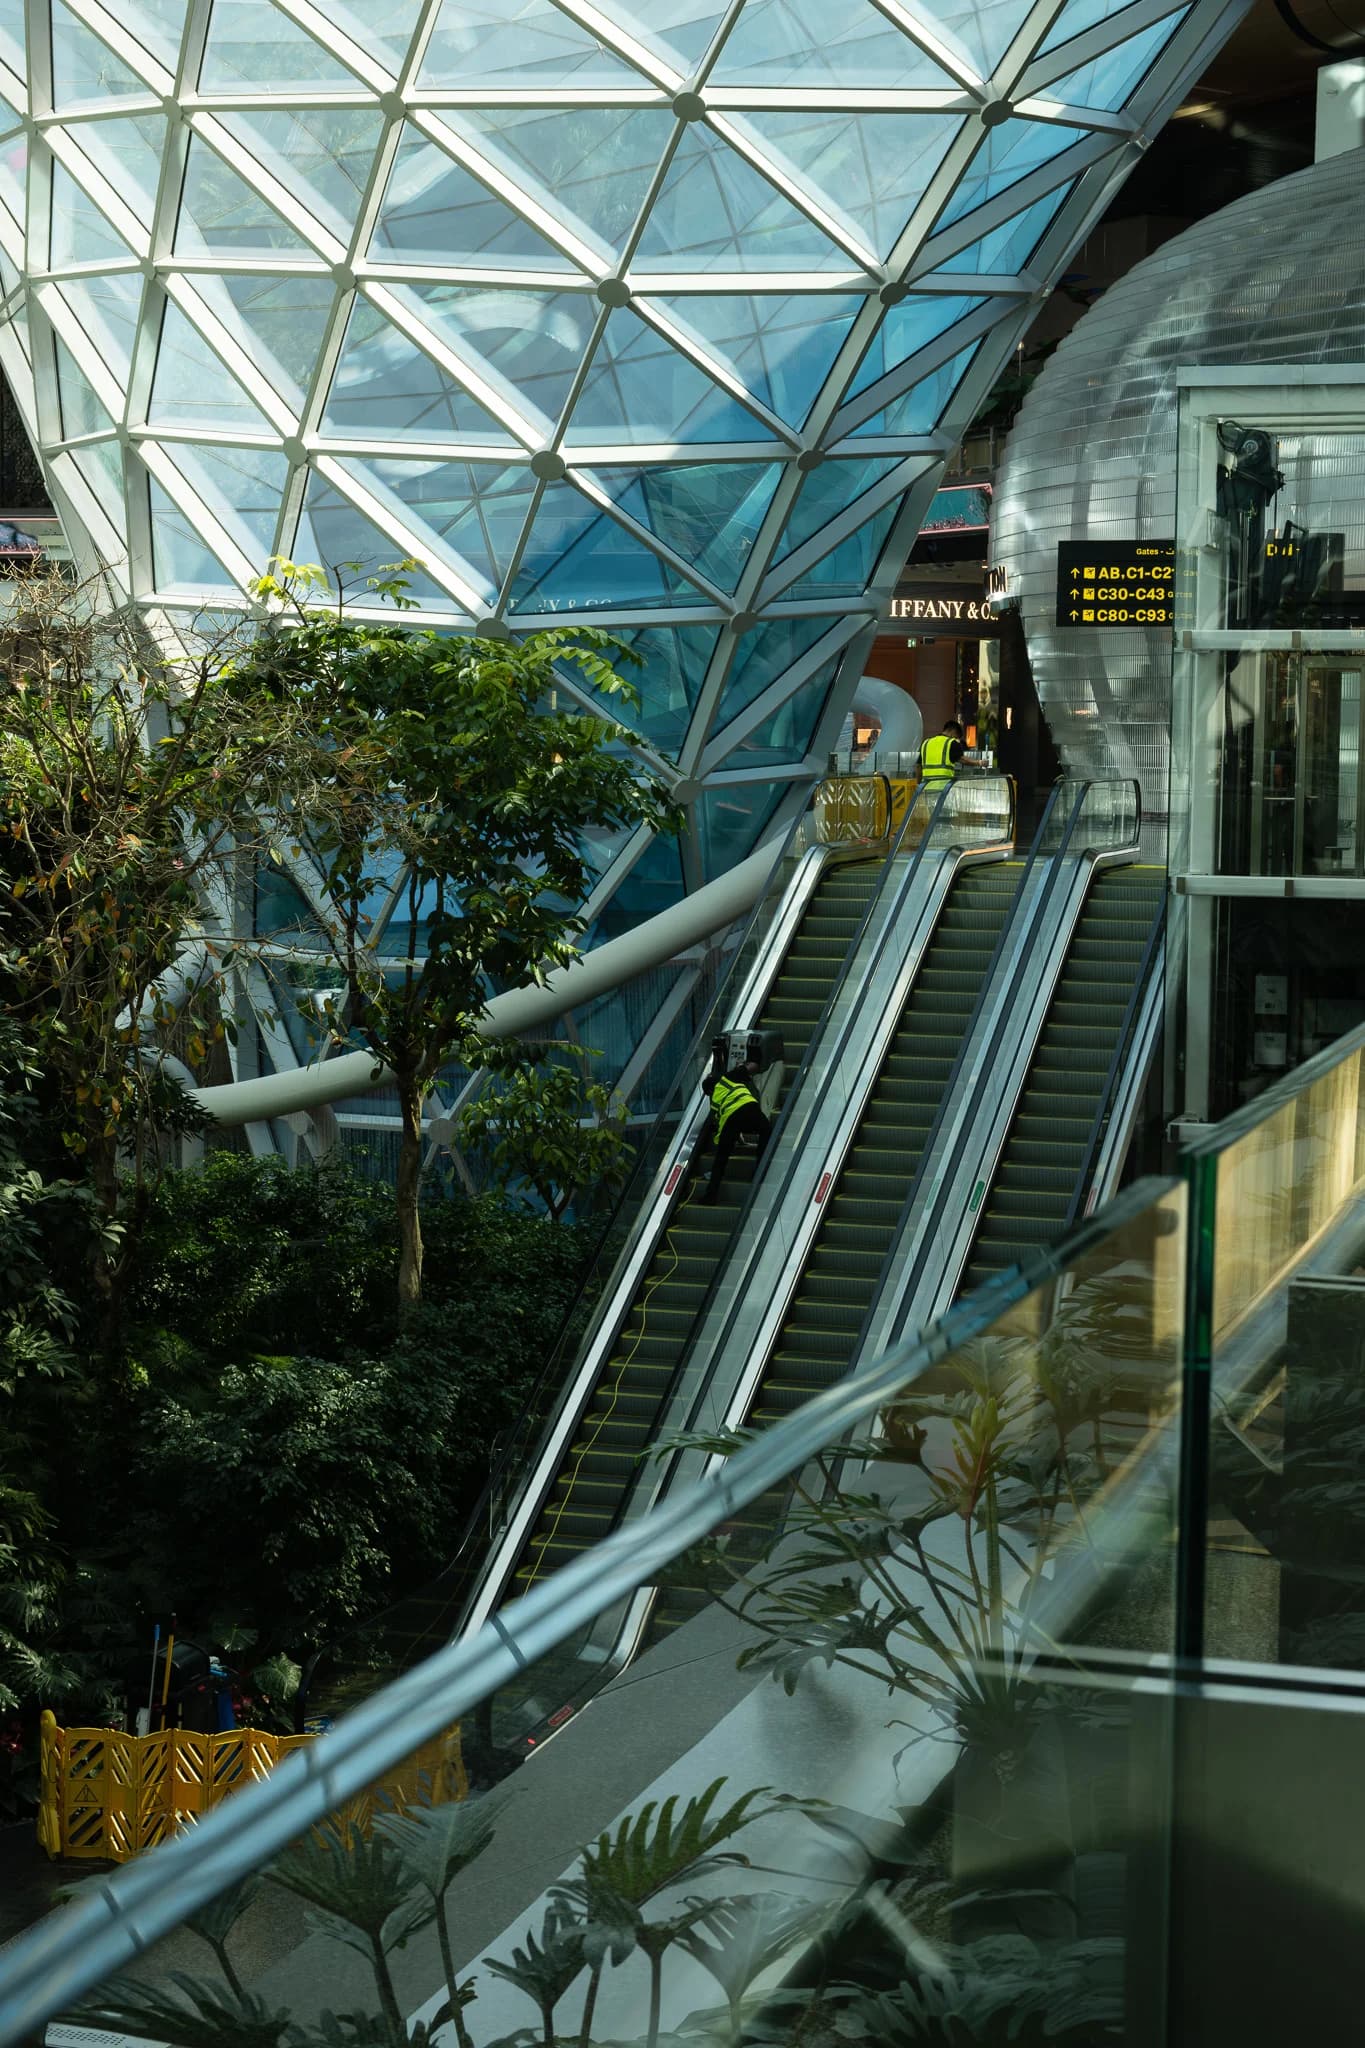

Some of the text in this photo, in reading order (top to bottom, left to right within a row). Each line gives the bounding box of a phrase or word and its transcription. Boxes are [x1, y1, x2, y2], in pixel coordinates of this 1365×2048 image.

[1136, 548, 1159, 556] Gates
[1098, 567, 1175, 580] AB,C1-C2
[1097, 588, 1165, 601] C30-C43
[889, 599, 999, 621] IFFANY & C.
[1096, 609, 1166, 622] C80-C93
